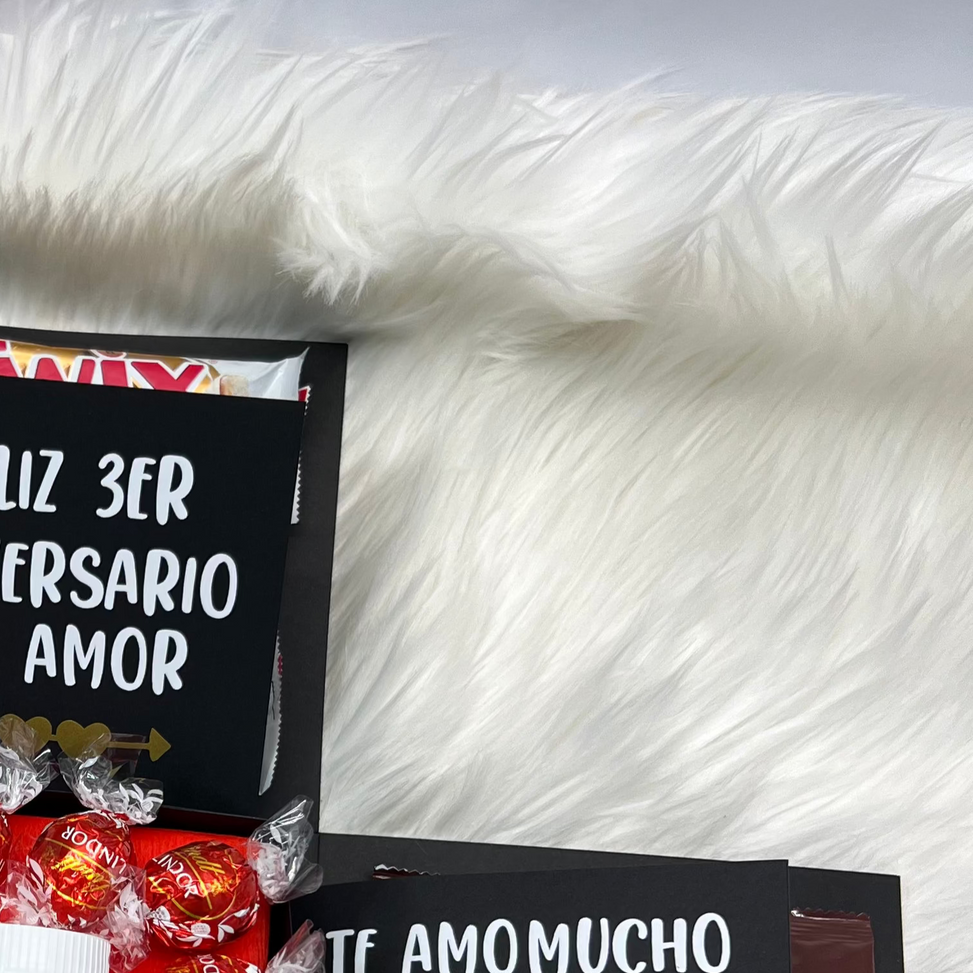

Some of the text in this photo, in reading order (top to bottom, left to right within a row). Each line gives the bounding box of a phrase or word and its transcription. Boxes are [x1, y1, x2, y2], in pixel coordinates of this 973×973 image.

[96, 452, 195, 525] 3ER
[24, 623, 189, 696] AMOR
[61, 825, 127, 875] LINDOR
